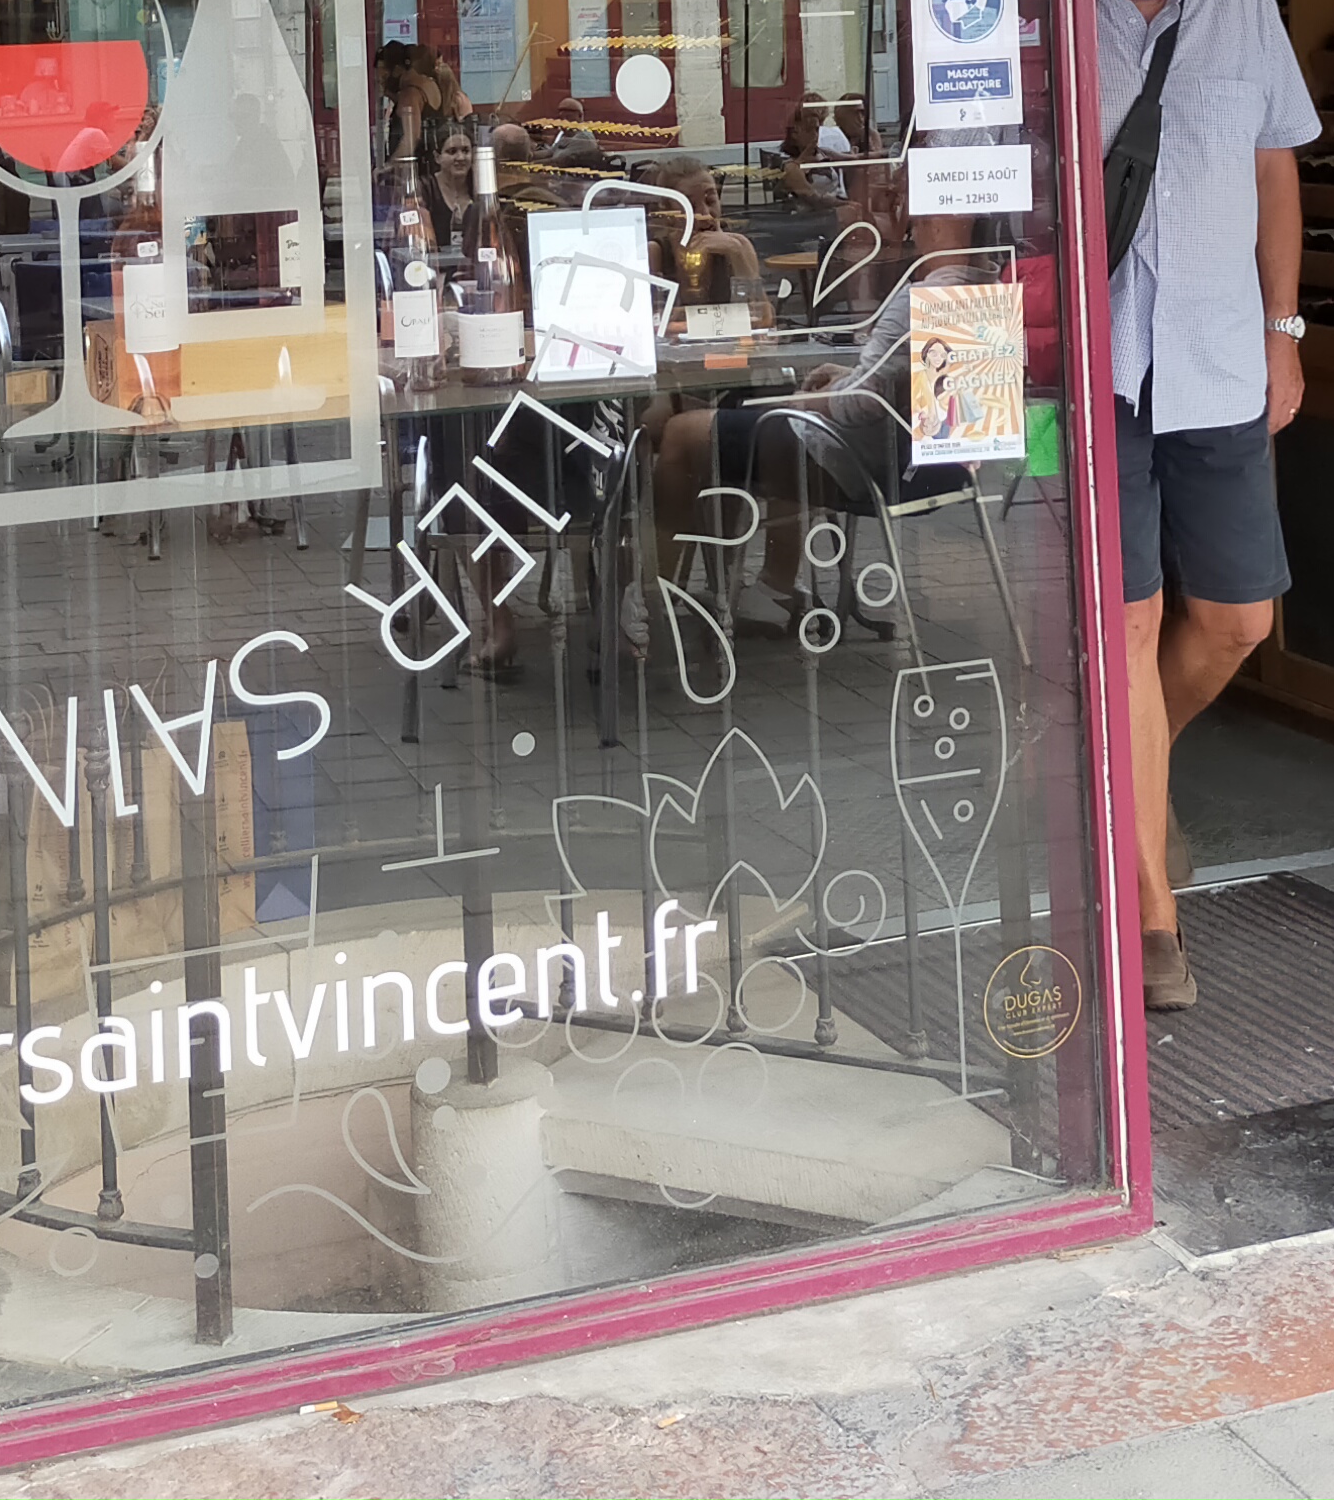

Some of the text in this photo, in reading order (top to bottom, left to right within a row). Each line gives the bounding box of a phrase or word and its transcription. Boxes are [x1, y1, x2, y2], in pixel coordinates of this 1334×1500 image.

[946, 67, 990, 79] MASQUE
[935, 78, 1002, 92] OBLIGATOIRE
[926, 167, 1018, 183] SAMEDI 15 AOÛT
[938, 193, 953, 206] 9H
[965, 192, 999, 204] 12H30
[947, 344, 1016, 364] GRATTEZ
[942, 369, 1017, 392] GAGNEZ
[1004, 985, 1062, 1012] DUGAS
[1005, 1009, 1028, 1019] CLUB
